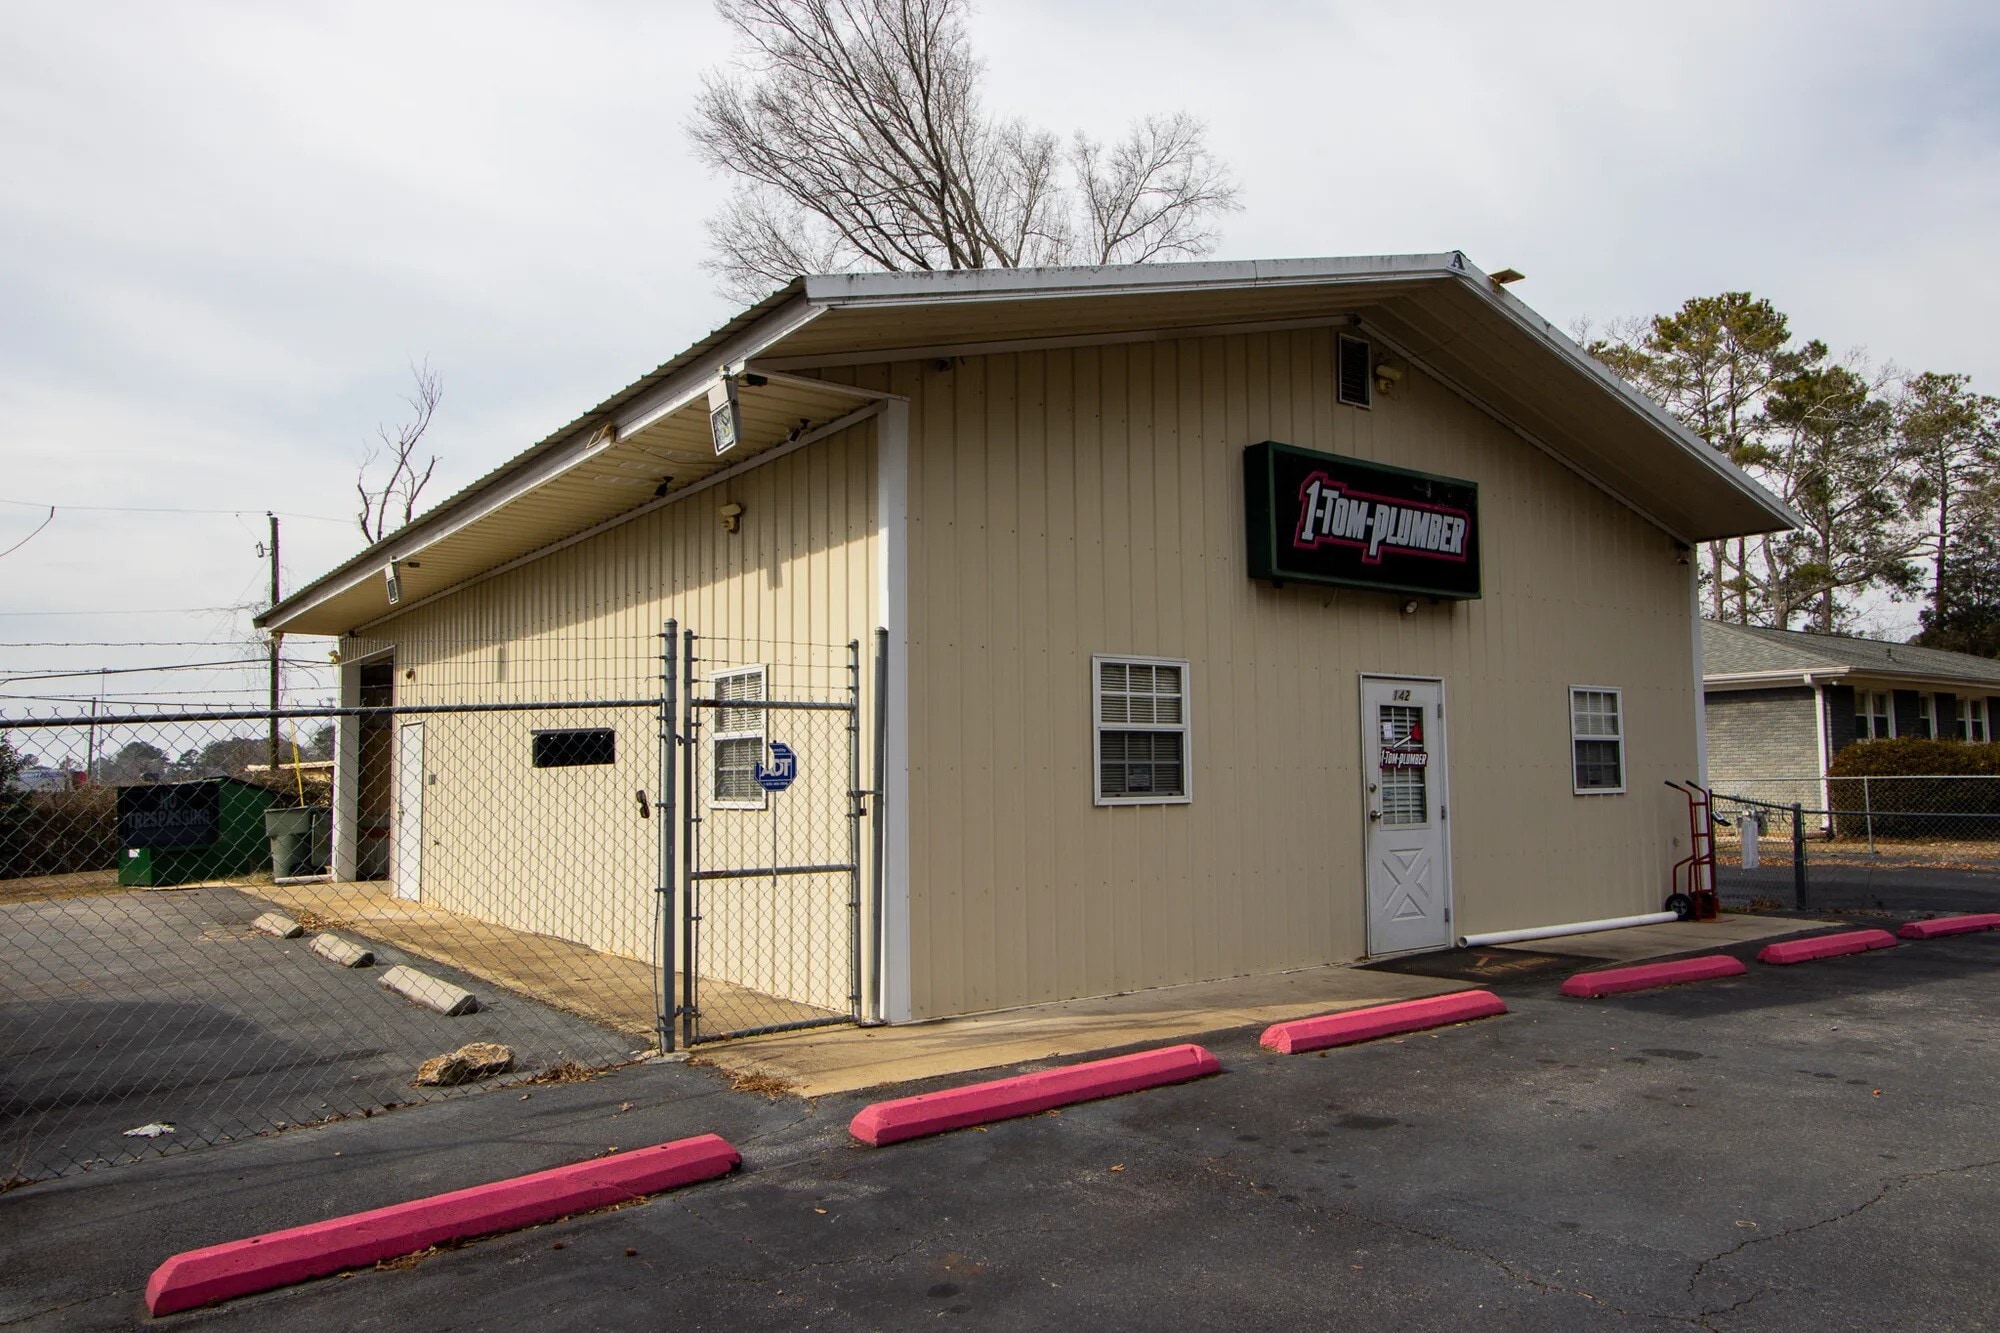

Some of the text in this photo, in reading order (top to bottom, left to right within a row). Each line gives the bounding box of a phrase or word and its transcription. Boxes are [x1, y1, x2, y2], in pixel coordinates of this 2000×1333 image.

[1301, 480, 1466, 556] 1-TOM-PLUMBER
[1393, 690, 1411, 701] 142
[160, 791, 178, 810] NO
[128, 808, 210, 829] TRESPASSING
